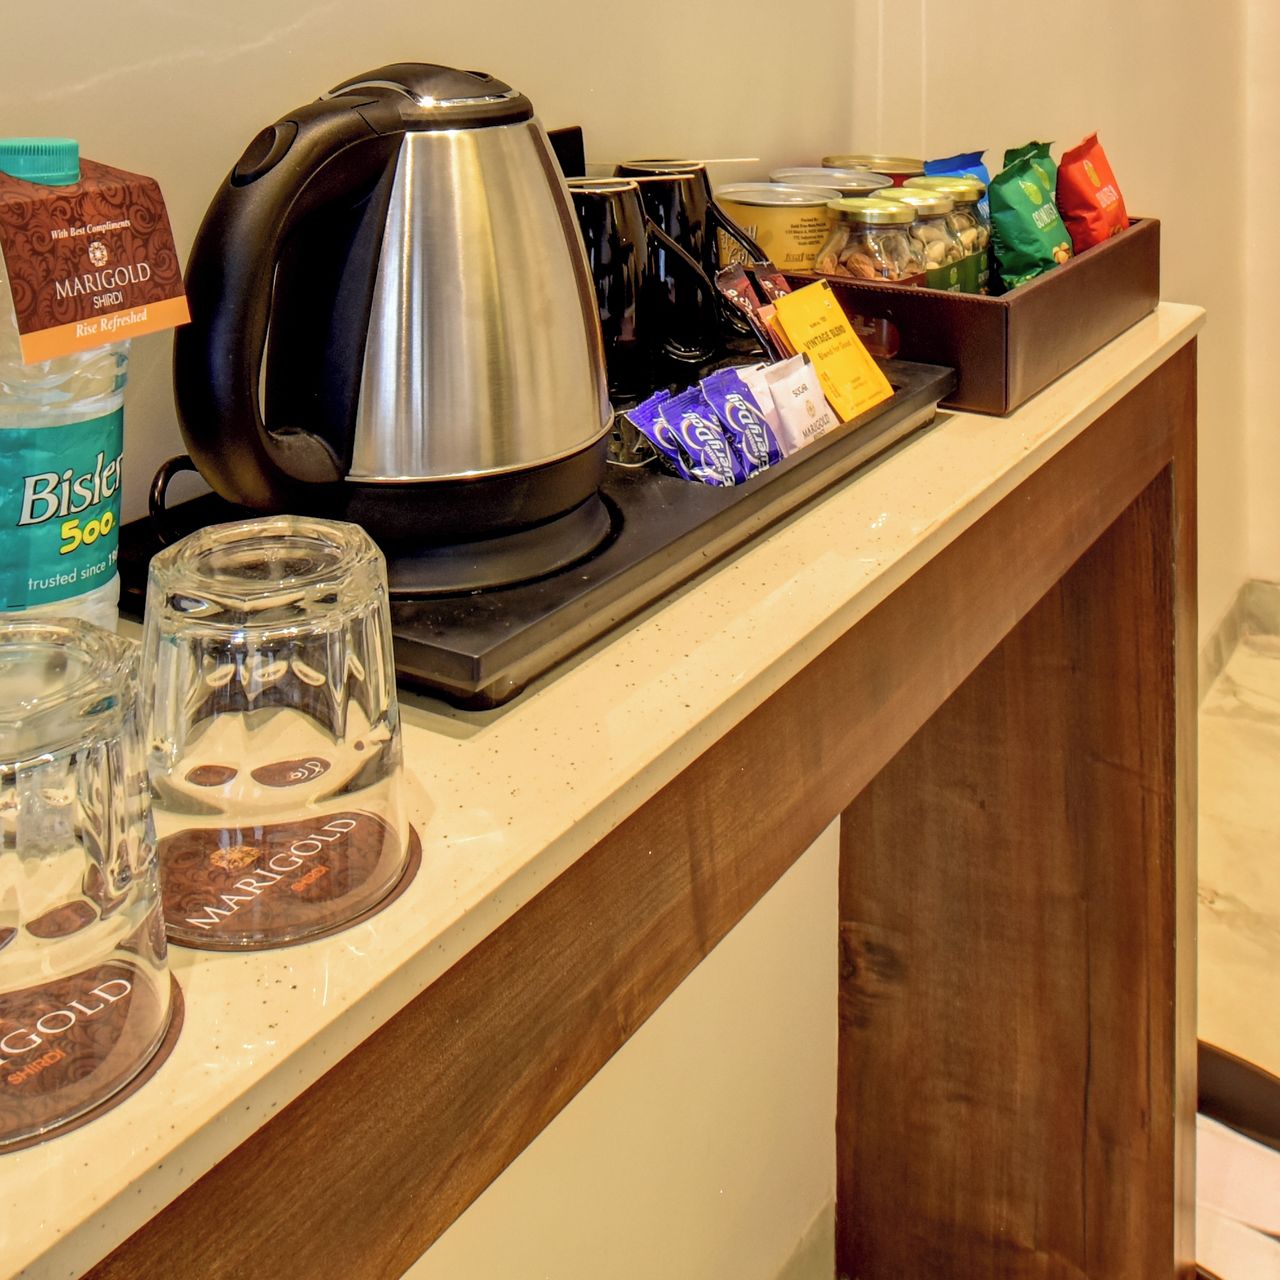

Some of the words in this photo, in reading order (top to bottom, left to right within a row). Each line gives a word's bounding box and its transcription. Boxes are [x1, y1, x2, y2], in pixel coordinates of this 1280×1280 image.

[51, 228, 68, 240] With
[70, 226, 85, 236] Best
[86, 220, 131, 234] Compliments
[55, 262, 151, 300] MARIGOLD
[93, 291, 123, 309] SHIRDI
[76, 322, 98, 338] Rise
[100, 308, 147, 332] Refreshed
[17, 451, 123, 527] Bisler
[59, 511, 114, 555] 500
[28, 566, 76, 590] trusted
[81, 561, 106, 580] since
[185, 819, 357, 930] MARIGOLD
[7, 1048, 66, 1086] SHIRDI
